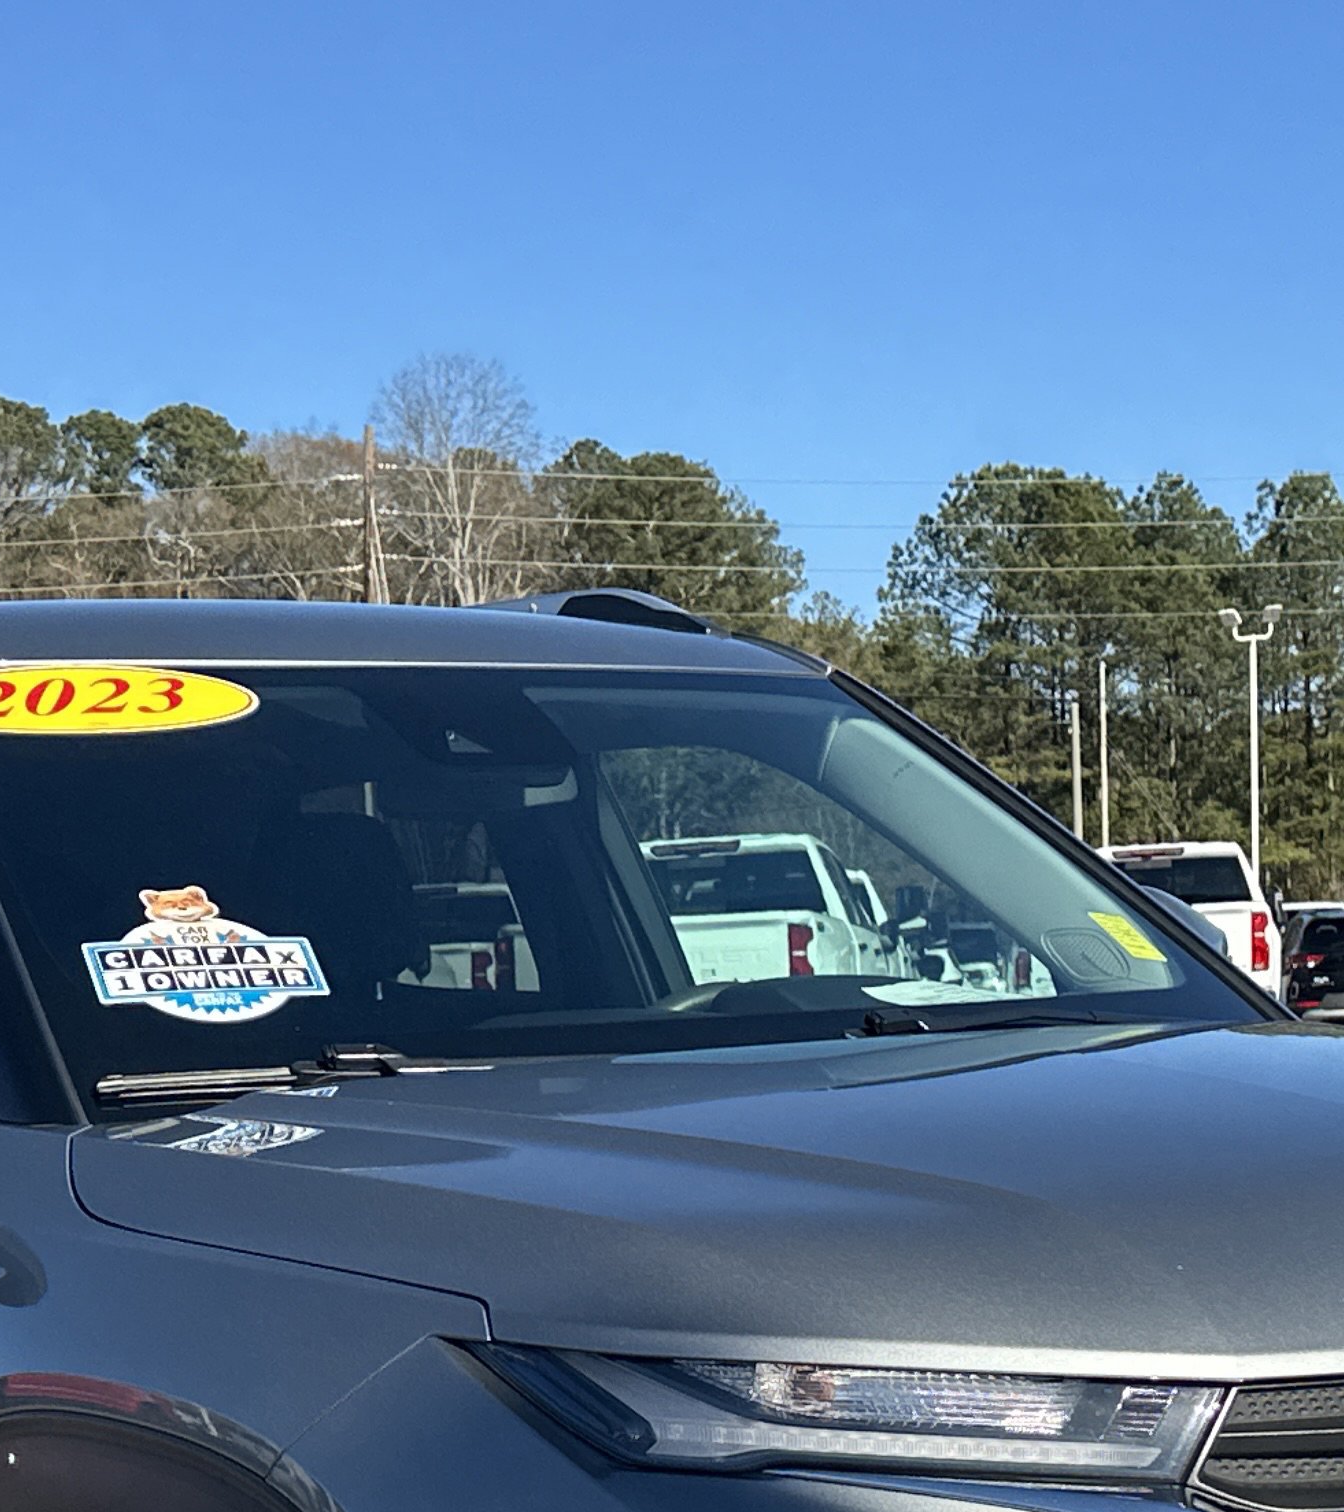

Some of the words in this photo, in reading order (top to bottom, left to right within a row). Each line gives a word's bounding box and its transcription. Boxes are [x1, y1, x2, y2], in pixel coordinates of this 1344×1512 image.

[176, 926, 209, 935] CAR
[181, 934, 211, 944] FOX
[102, 946, 300, 969] CARFAX
[114, 975, 135, 991] 1
[146, 968, 309, 991] OWNER
